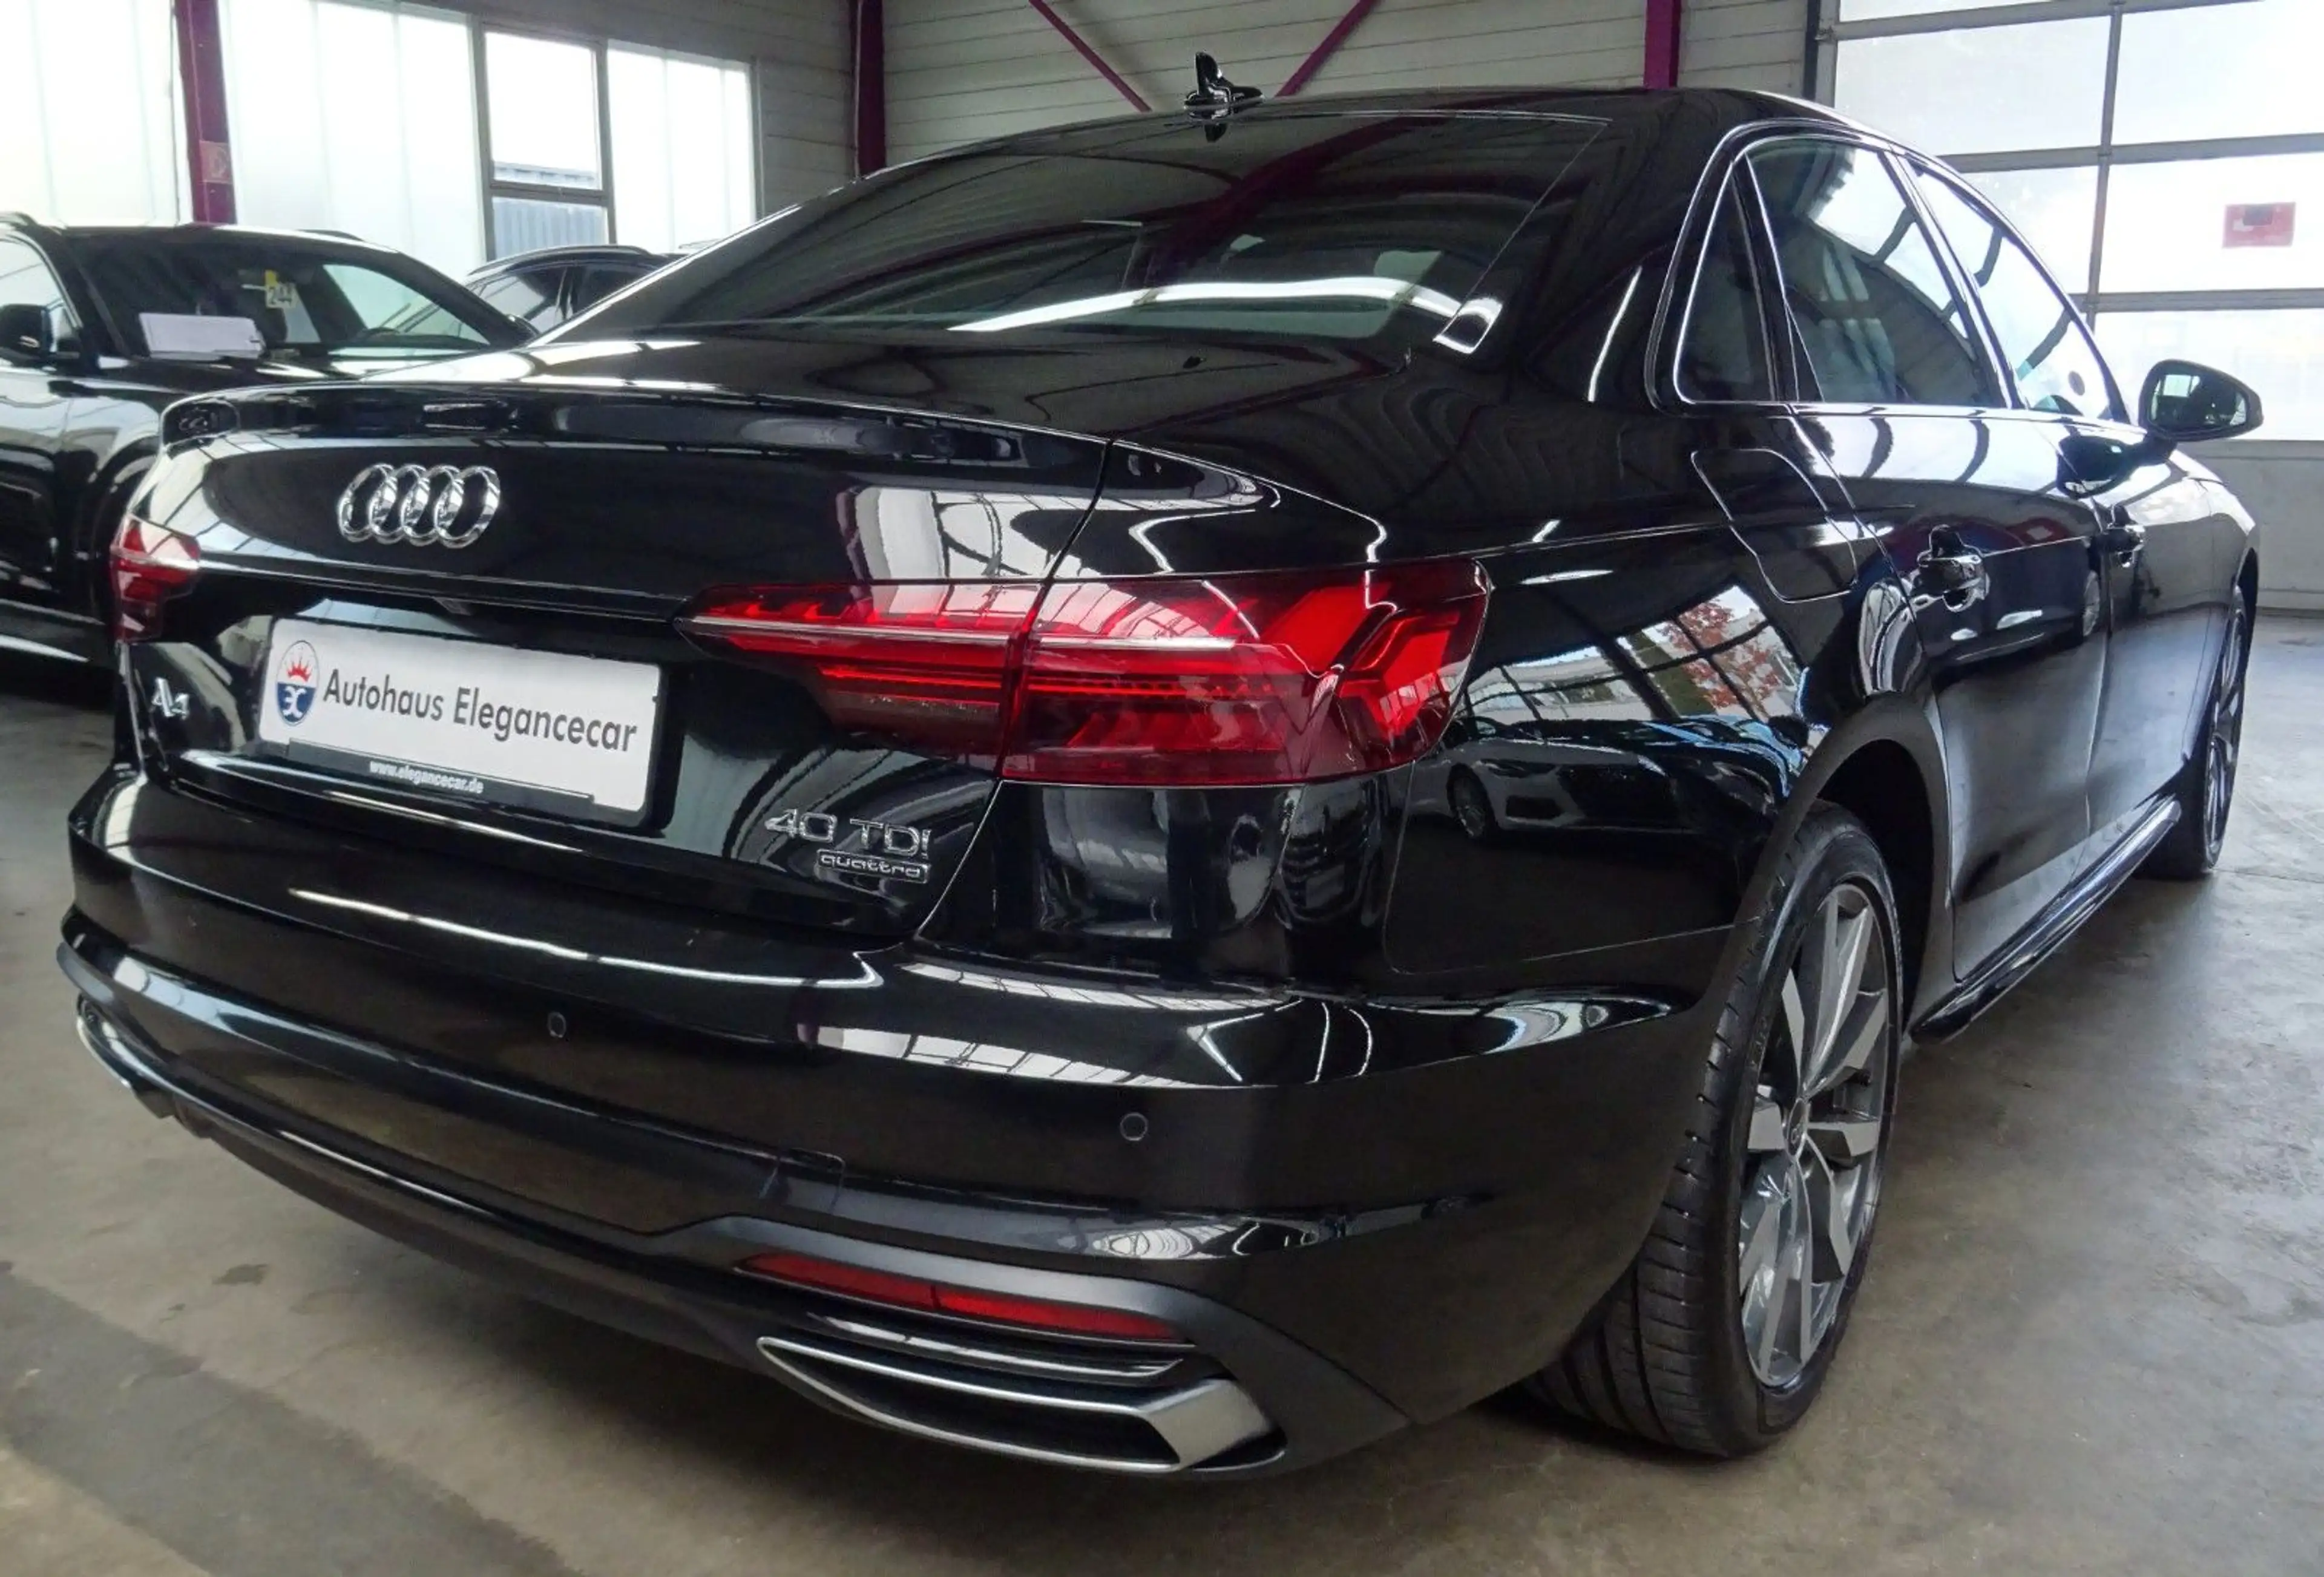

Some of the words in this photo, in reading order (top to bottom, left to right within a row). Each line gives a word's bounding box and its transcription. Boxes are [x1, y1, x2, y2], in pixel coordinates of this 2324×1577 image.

[149, 677, 189, 720] A4
[323, 668, 444, 722] Autohaus
[453, 687, 638, 752] Elegancecar
[370, 760, 484, 794] www.elegancecar.de
[764, 809, 838, 842] 40
[850, 818, 931, 859] TDI
[820, 854, 921, 877] quattro
